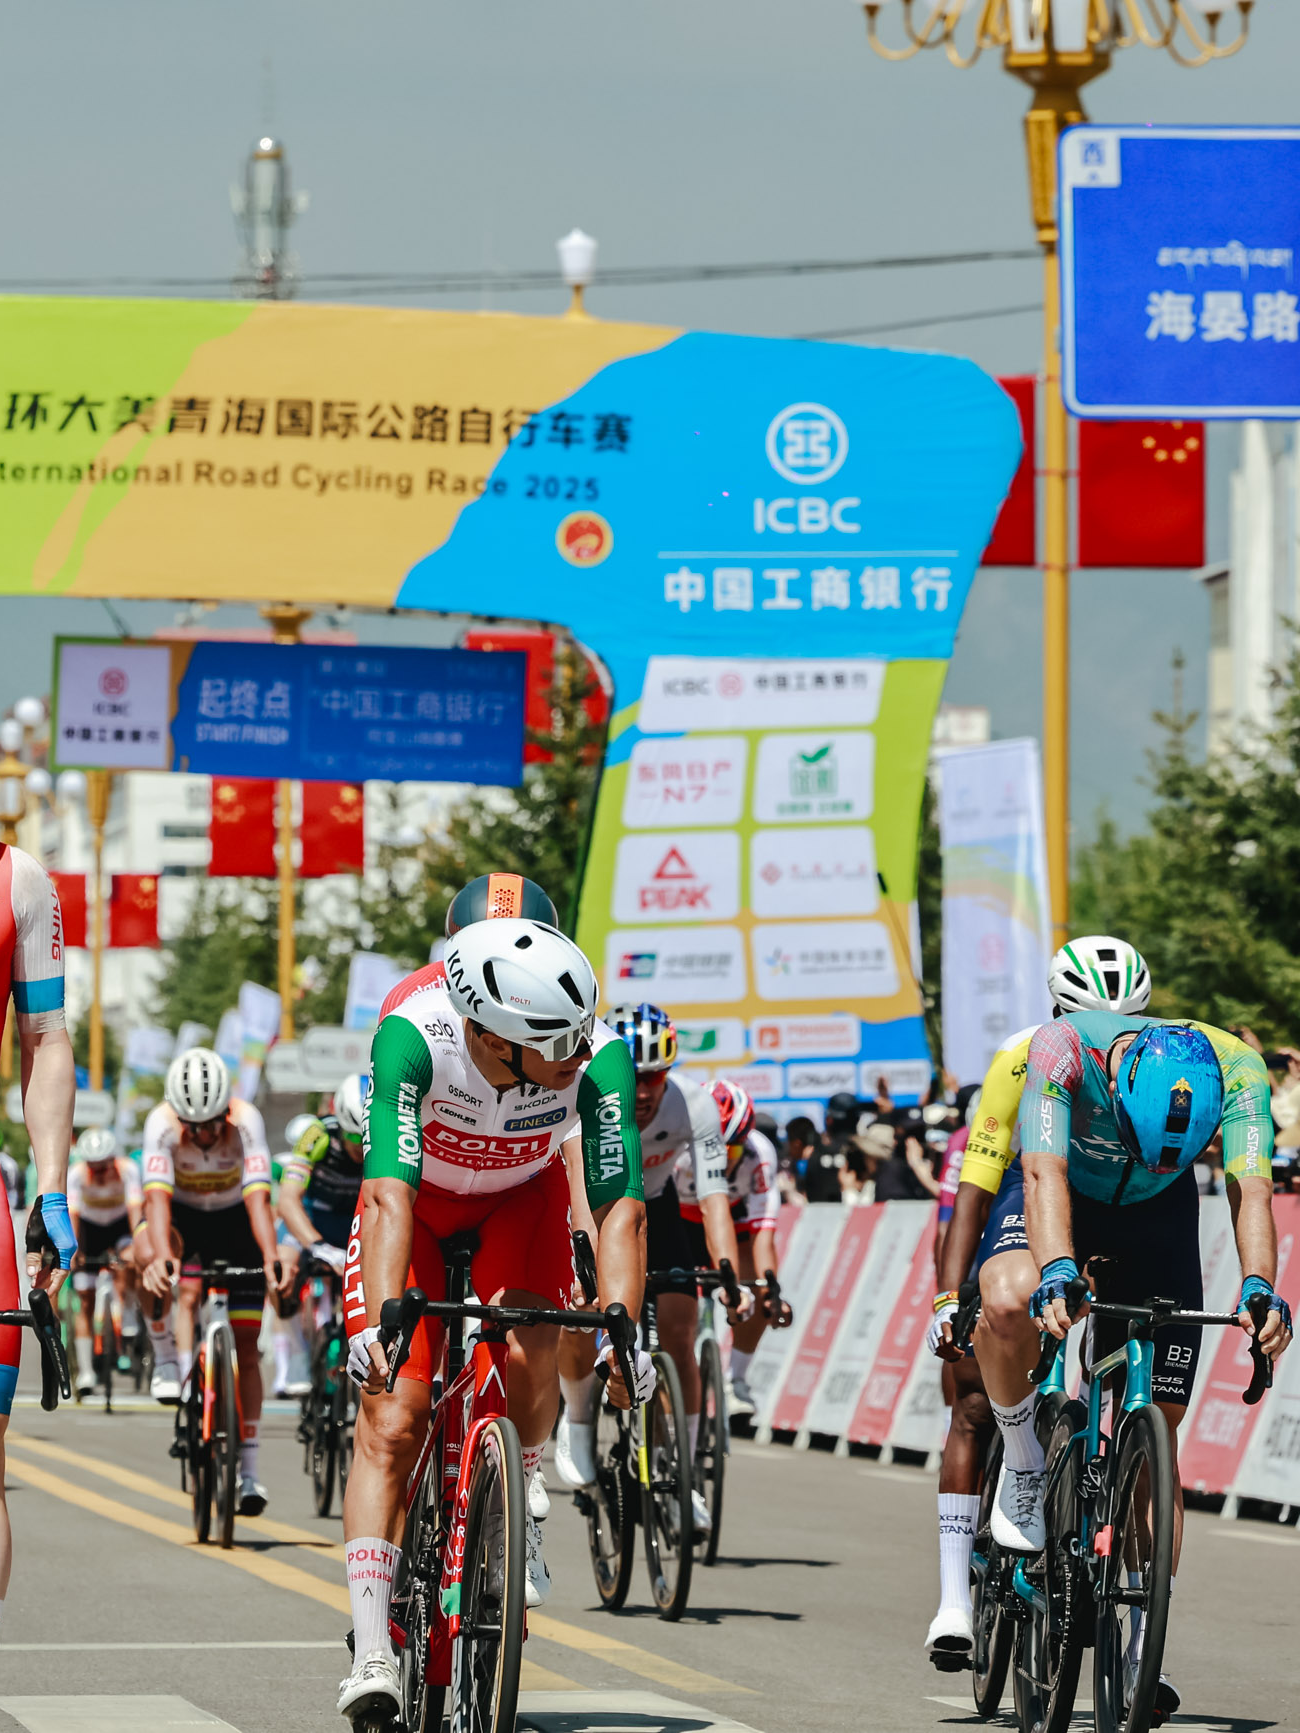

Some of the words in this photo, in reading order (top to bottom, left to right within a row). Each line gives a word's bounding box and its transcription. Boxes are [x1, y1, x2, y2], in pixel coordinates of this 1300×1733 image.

[1145, 290, 1300, 343] 海晏路
[194, 460, 279, 489] Road
[291, 463, 414, 498] Cycling
[426, 469, 508, 497] Race
[525, 474, 601, 501] 2025
[754, 497, 861, 534] ICBC
[664, 566, 952, 614] 中国工商银行
[663, 677, 712, 697] ICBC
[755, 671, 869, 693] 中国工商银行
[199, 678, 291, 720] 起终点
[662, 785, 707, 803] N7
[638, 885, 712, 911] PEAK
[448, 950, 485, 1015] KASK
[510, 995, 532, 1006] POLTI
[425, 1019, 454, 1038] solo
[1050, 1050, 1074, 1081] FREEDOM
[448, 1084, 484, 1108] GSPORT
[398, 1082, 422, 1168] KOMETA
[510, 1111, 564, 1130] FINECO
[436, 1130, 539, 1155] POLTI
[596, 1091, 624, 1181] KOMETA
[976, 1130, 997, 1144] ICBC
[1245, 1126, 1261, 1171] ASTANA
[993, 1239, 1029, 1250] ASTA
[345, 1213, 367, 1320] POLTI
[1167, 1344, 1193, 1364] B3
[1151, 1385, 1186, 1396] TANA
[995, 1411, 1033, 1427] STANA
[939, 1525, 974, 1537] STANA
[347, 1548, 393, 1567] POLTI
